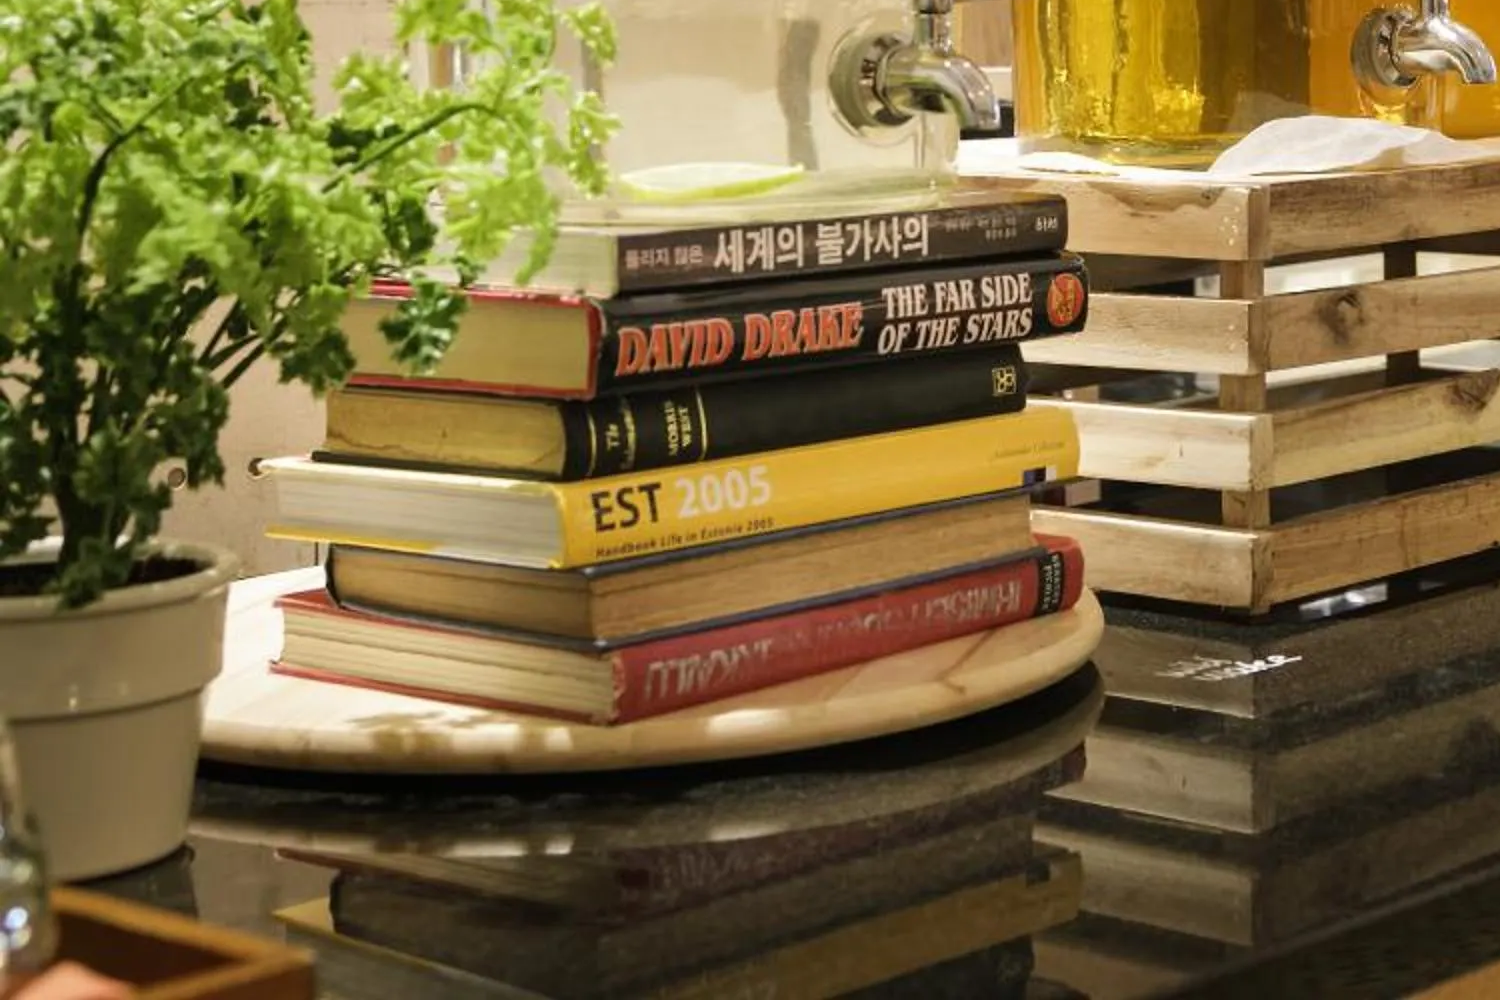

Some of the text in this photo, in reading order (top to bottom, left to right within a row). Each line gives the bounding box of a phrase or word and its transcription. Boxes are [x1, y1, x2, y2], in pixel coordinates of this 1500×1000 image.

[714, 223, 804, 273] 세계의
[815, 213, 929, 265] 불가사의
[881, 282, 929, 320] THE
[933, 278, 977, 314] FAR
[979, 271, 1033, 308] SIDE
[614, 301, 864, 377] DAVID DRAKE
[877, 306, 1033, 356] OF THE STARS
[589, 463, 772, 534] EST 2005
[685, 529, 698, 542] in
